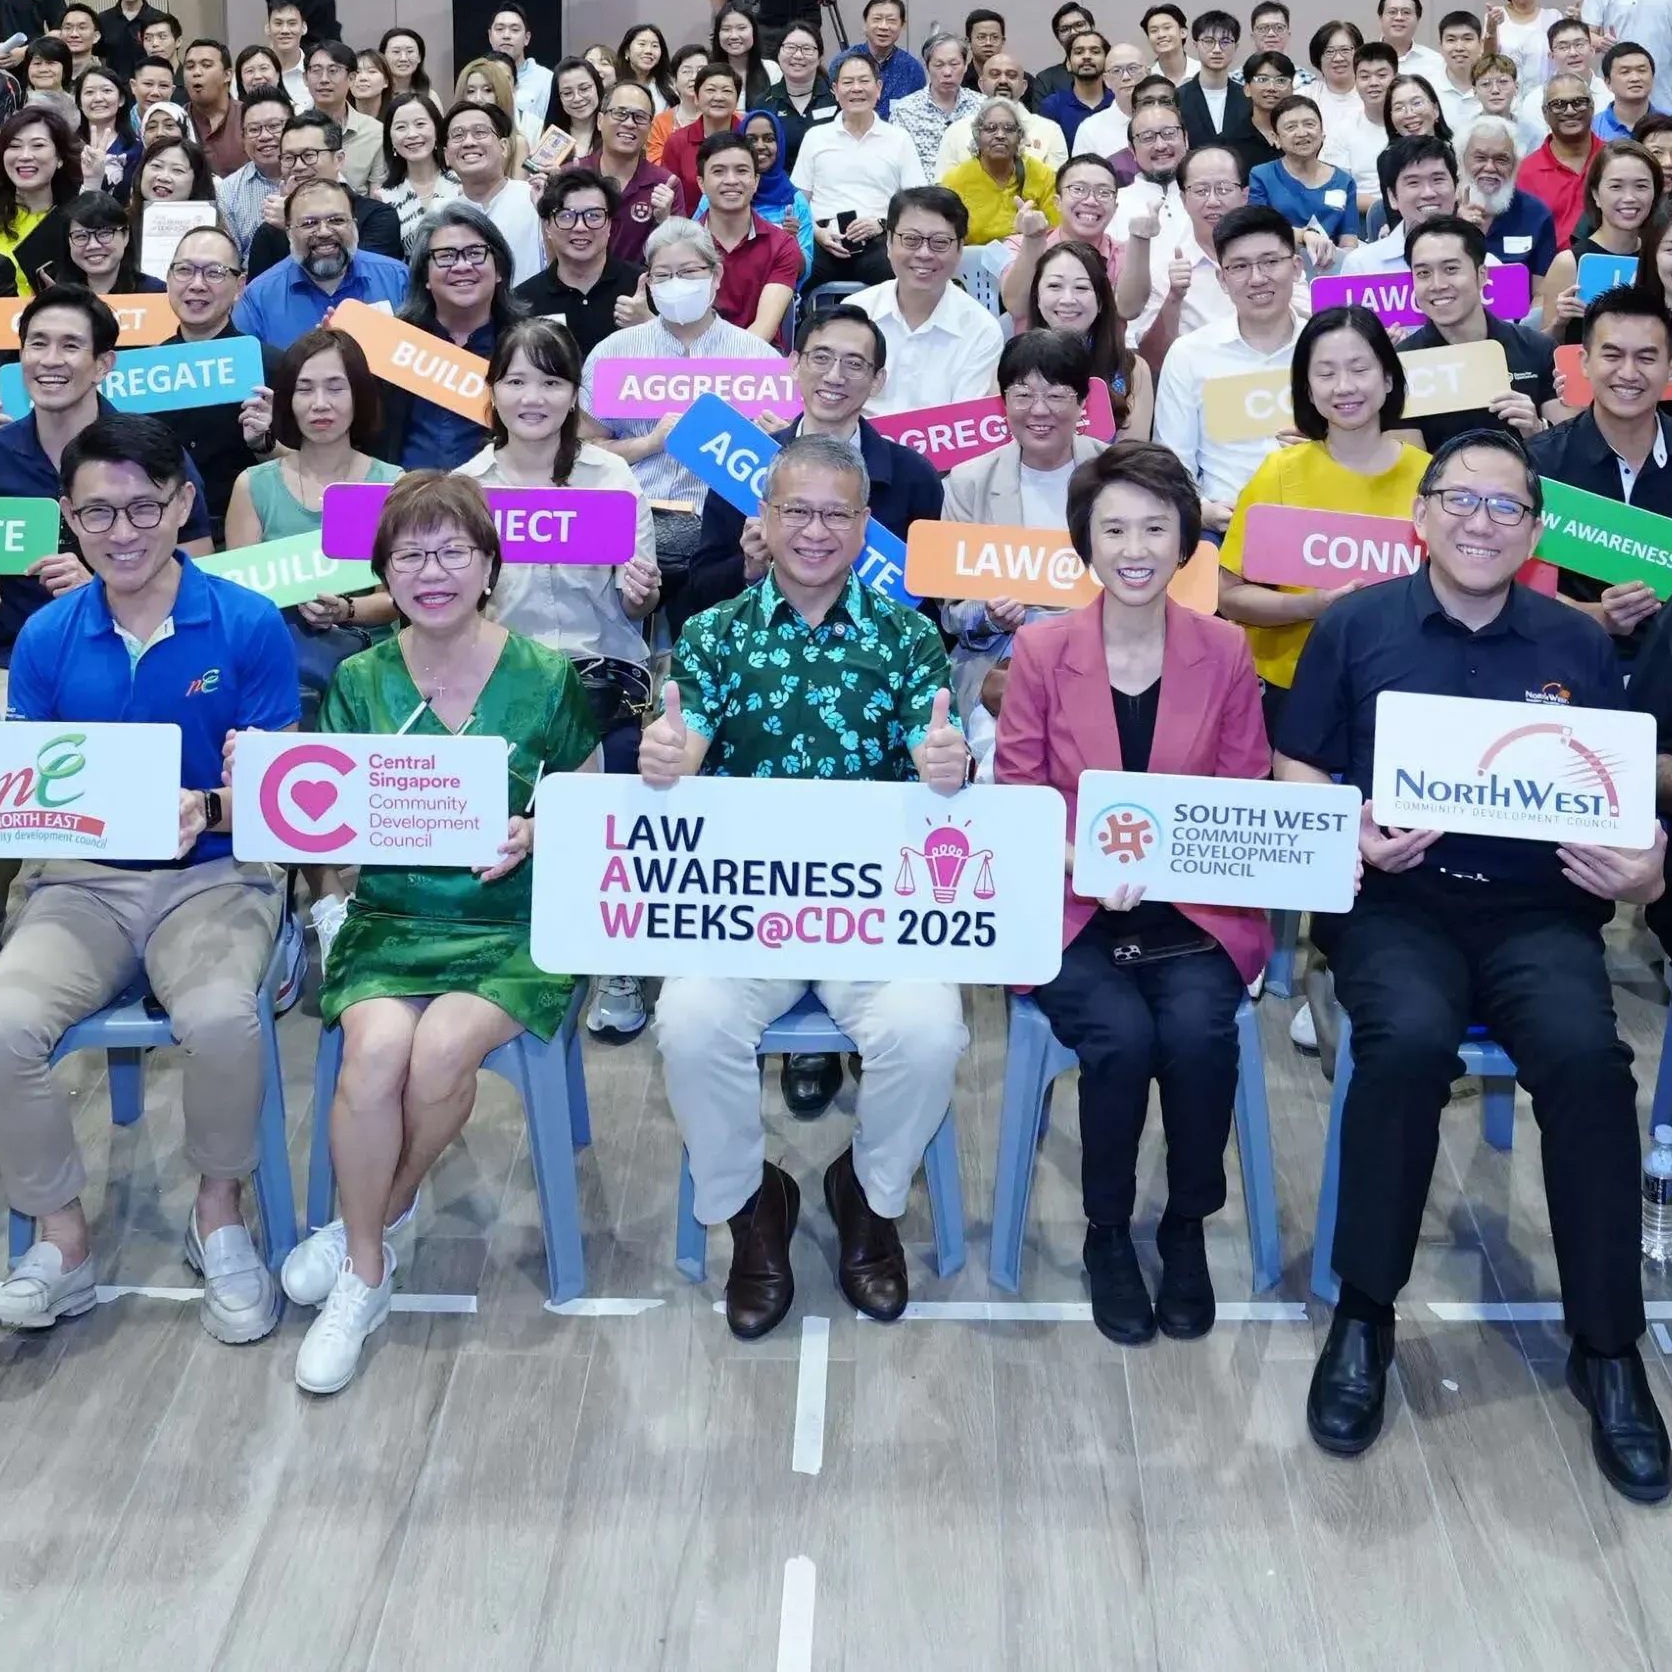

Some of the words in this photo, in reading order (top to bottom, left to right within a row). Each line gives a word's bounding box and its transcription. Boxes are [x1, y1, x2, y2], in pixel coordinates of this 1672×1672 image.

[392, 341, 486, 399] BUILD
[619, 374, 795, 403] AGGREGAT
[369, 754, 435, 770] Central
[369, 773, 461, 792] Singapore
[369, 794, 467, 815] Community
[1395, 800, 1465, 815] COMMUNITY
[1472, 808, 1559, 823] DEVELOPMENT
[1567, 817, 1620, 829] COUNCIL
[45, 813, 82, 830] EAST
[370, 813, 480, 832] Development
[1174, 804, 1266, 827] SOUTH
[1274, 810, 1348, 832] WEST
[15, 829, 73, 844] development
[75, 834, 108, 849] council
[370, 832, 432, 848] Council
[606, 814, 704, 852] LAW
[1172, 827, 1299, 847] COMMUNITY
[1171, 842, 1315, 865] DEVELOPMENT
[600, 856, 883, 900] AWARENESS
[1170, 859, 1255, 878] COUNCIL
[600, 901, 886, 949] WEEKS@CDC
[897, 909, 997, 948] 2025
